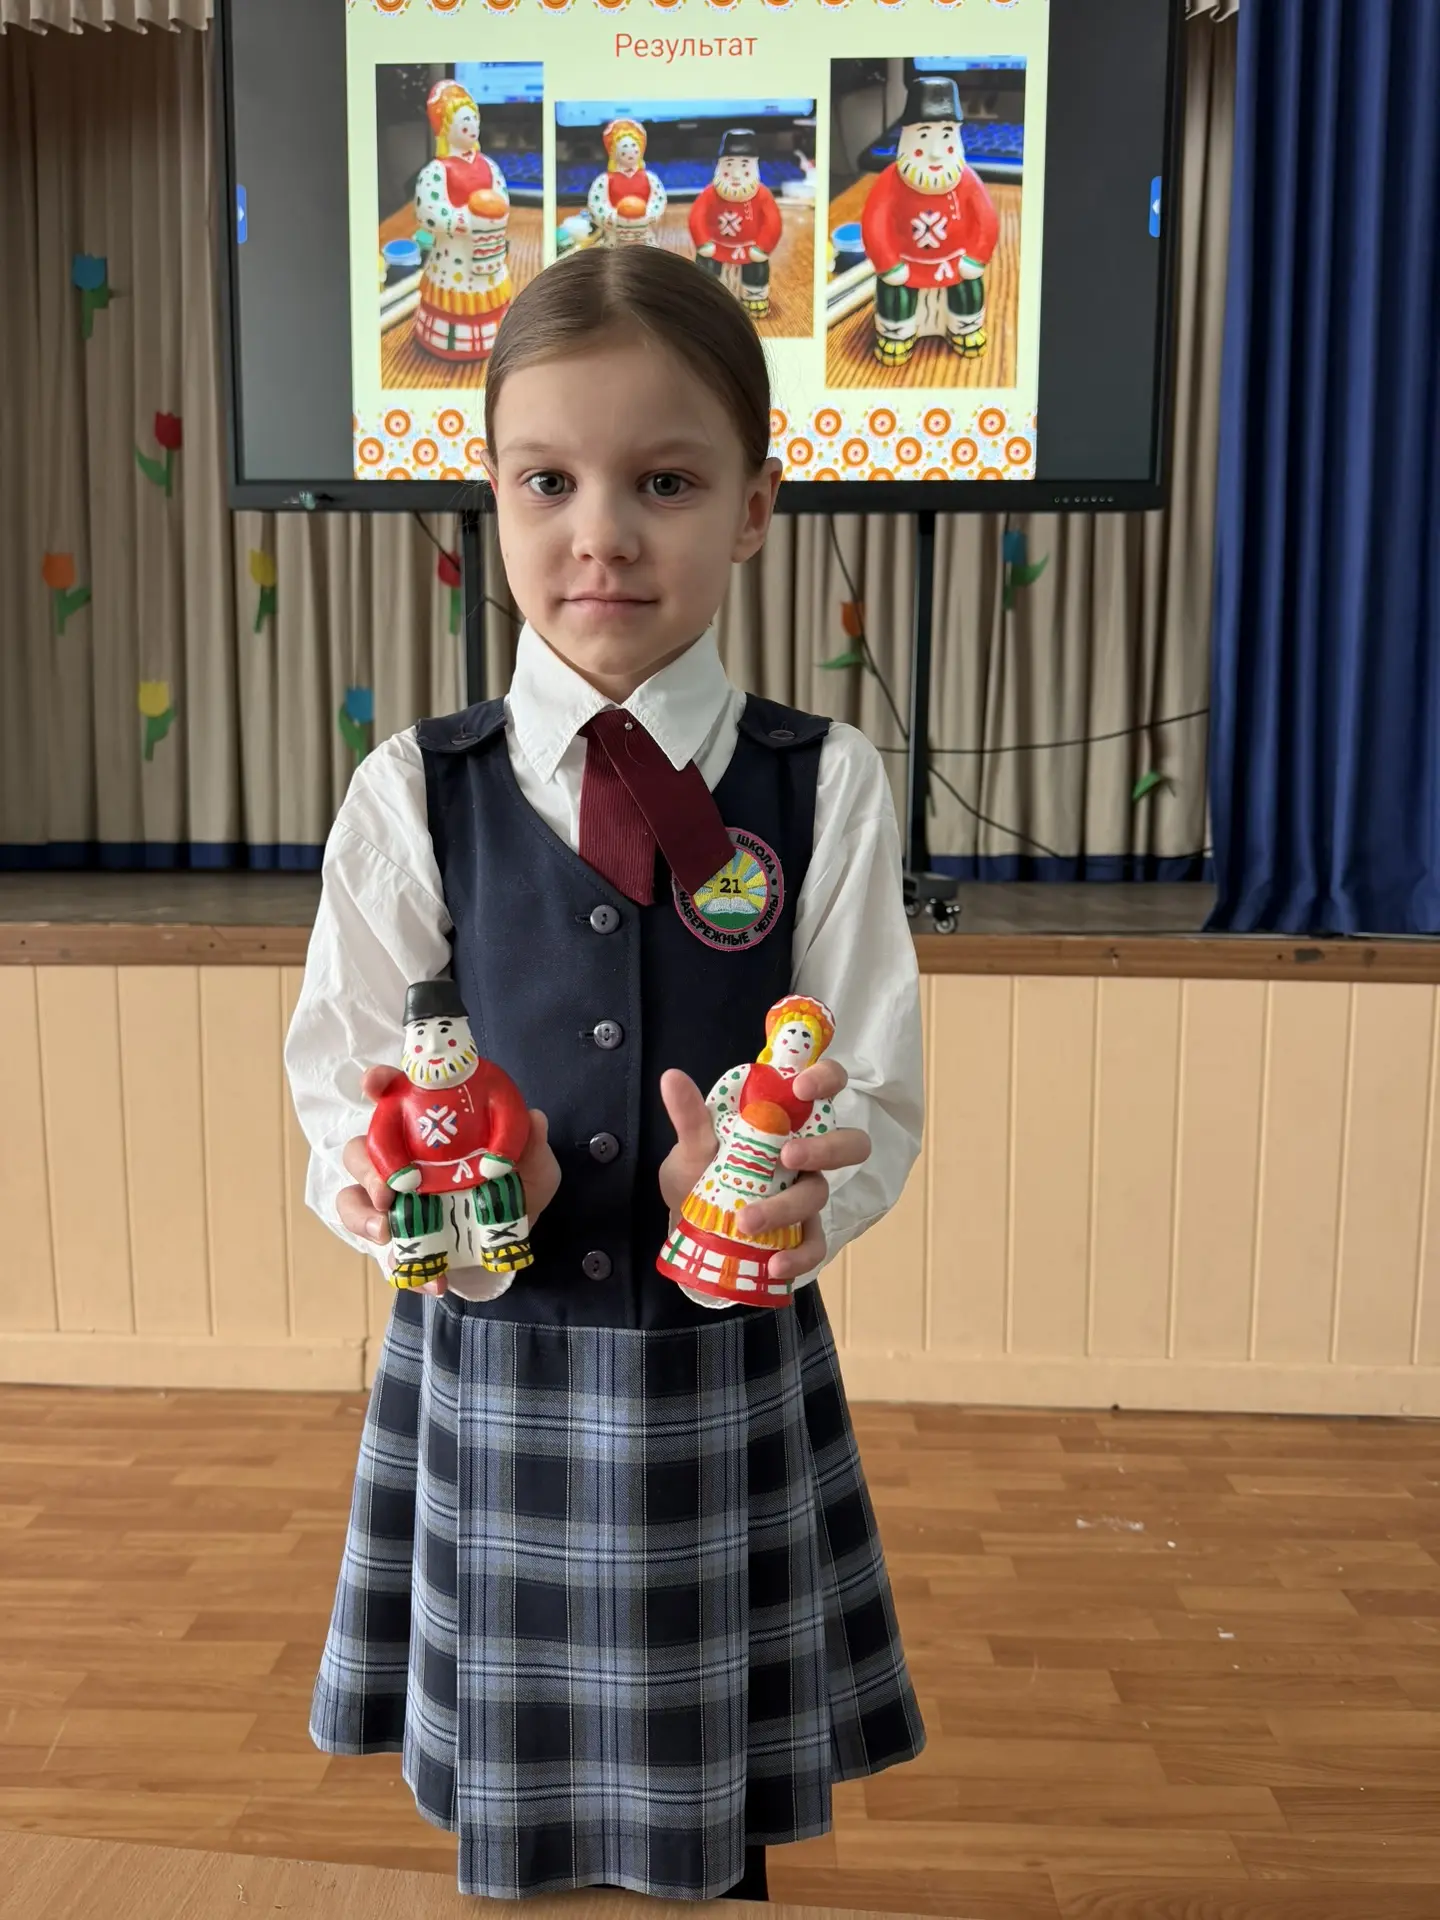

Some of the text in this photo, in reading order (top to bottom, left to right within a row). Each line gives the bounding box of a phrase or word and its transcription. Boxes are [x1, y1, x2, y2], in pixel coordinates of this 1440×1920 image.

[615, 33, 758, 64] Результат
[736, 834, 776, 874] ШКОЛА
[719, 877, 742, 894] 21
[679, 891, 779, 946] НАБЕРЕЖНЫЕ ЧЕЛНЫ
